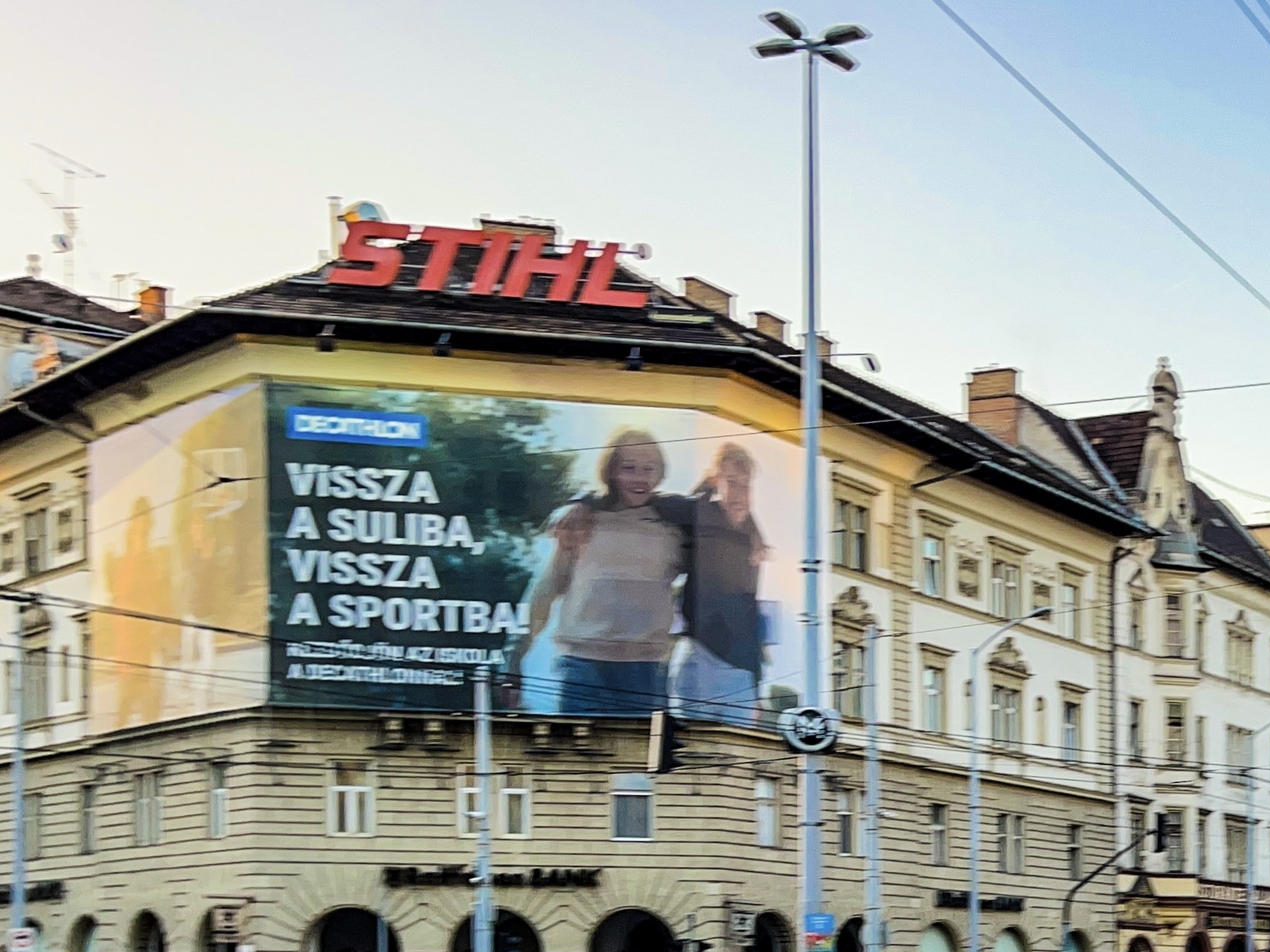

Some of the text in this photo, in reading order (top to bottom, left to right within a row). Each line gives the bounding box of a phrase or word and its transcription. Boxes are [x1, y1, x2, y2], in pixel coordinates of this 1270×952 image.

[327, 220, 648, 308] STIHL
[294, 414, 421, 439] DECATHLON
[285, 462, 440, 504] VISSZA
[286, 506, 486, 555] A SULIBA,
[286, 550, 440, 589] VISSZA
[286, 592, 531, 634] A SPORTBA!
